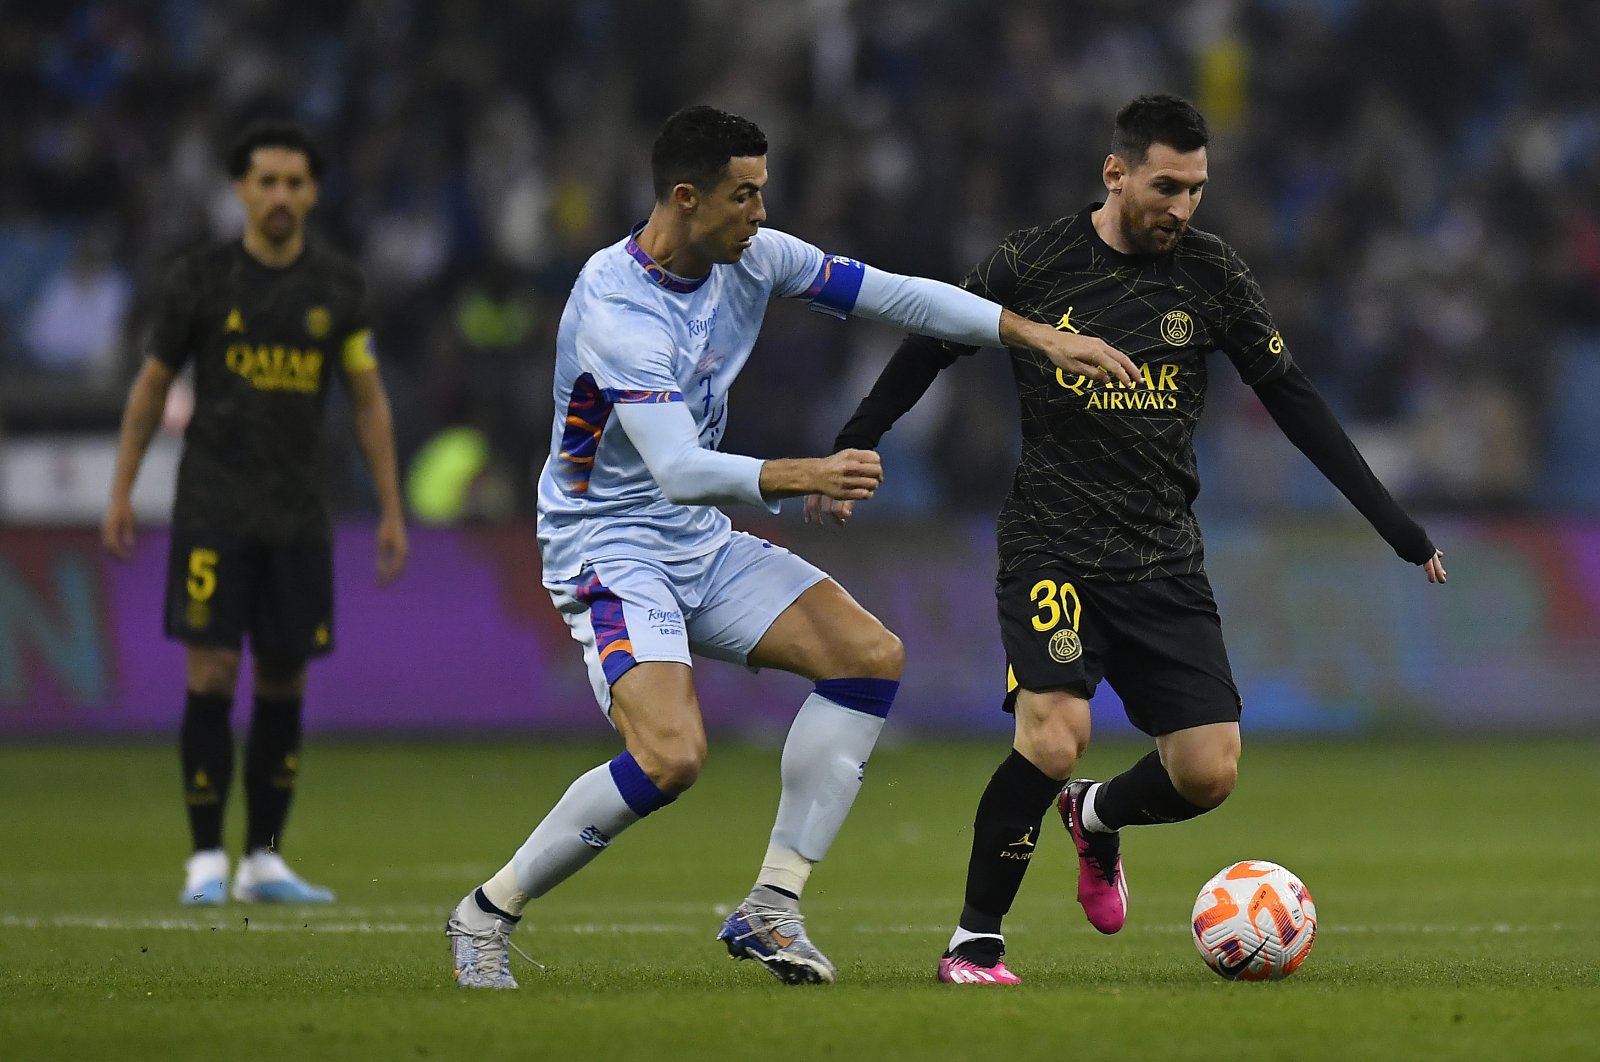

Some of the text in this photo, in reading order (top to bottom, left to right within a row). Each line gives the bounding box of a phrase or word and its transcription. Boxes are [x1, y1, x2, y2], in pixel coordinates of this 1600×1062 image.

[1056, 363, 1181, 396] QAR
[1085, 391, 1178, 410] AIRWAYS
[187, 548, 218, 601] 5
[1030, 579, 1081, 633] 30
